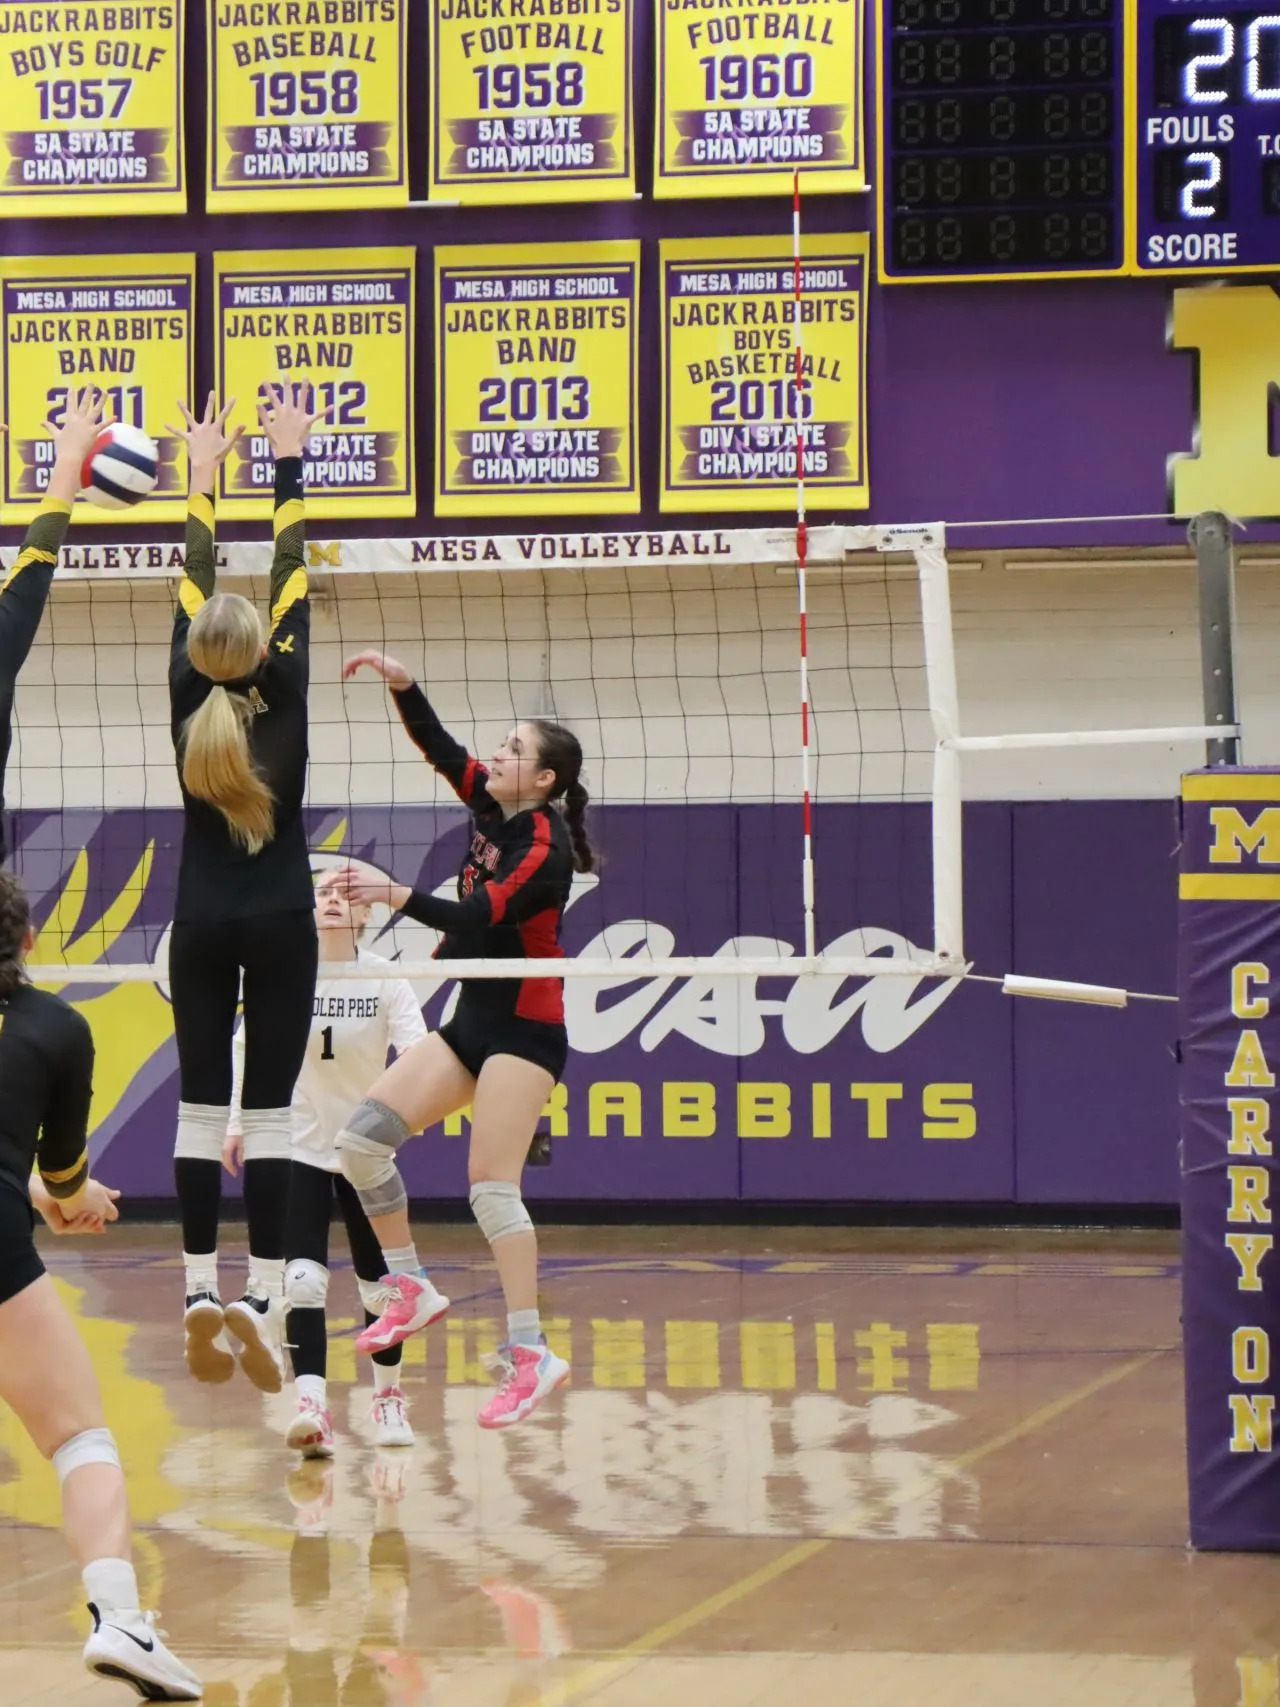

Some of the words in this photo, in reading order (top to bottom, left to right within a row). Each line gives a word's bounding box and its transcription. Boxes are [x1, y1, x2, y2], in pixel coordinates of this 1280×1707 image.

[219, 0, 394, 27] JACKRABBITS
[461, 23, 603, 58] FOOTBALL
[688, 14, 832, 48] FOOTBALL
[11, 41, 83, 76] BOYS
[96, 41, 166, 72] GOLF
[233, 31, 376, 67] BASEBALL
[473, 62, 582, 109] 1958
[700, 53, 811, 100] 1960
[35, 78, 132, 119] 1957
[250, 70, 357, 116] 1958
[706, 112, 733, 133] 5A
[737, 107, 810, 131] STATE
[1148, 115, 1233, 143] FOULS
[693, 135, 822, 159] CHAMPIONS
[1180, 151, 1221, 218] 2
[1149, 234, 1236, 261] SCORE
[18, 292, 65, 308] MESA
[73, 292, 108, 307] HIGH
[115, 290, 175, 306] SCHOOL
[456, 281, 504, 297] MESA
[512, 280, 549, 296] HIGH
[556, 278, 618, 295] SCHOOL
[227, 312, 401, 337] JACKRABBITS
[448, 306, 625, 333] JACKRABBITS
[673, 298, 855, 327] JACKRABBITS
[10, 317, 183, 343] JACKRABBITS
[735, 329, 790, 350] BOYS
[59, 348, 135, 374] BAND
[275, 342, 352, 369] BAND
[497, 337, 576, 364] BAND
[687, 353, 842, 384] BASKETBALL
[480, 376, 588, 421] 2013
[710, 379, 813, 421] 2016
[310, 435, 376, 455] STATE
[473, 433, 505, 452] DIV
[513, 432, 525, 452] 2
[532, 431, 599, 451] STATE
[701, 428, 733, 447] DIV
[743, 427, 749, 446] 1
[756, 425, 826, 447] STATE
[473, 457, 598, 479] CHAMPIONS
[699, 451, 828, 474] CHAMPIONS
[412, 539, 501, 562] MESA
[517, 533, 730, 559] VOLLEYBALL
[312, 997, 345, 1017] DLER
[320, 1025, 335, 1060] 1
[1225, 962, 1275, 1291] CARRY
[1229, 1326, 1275, 1453] ON
